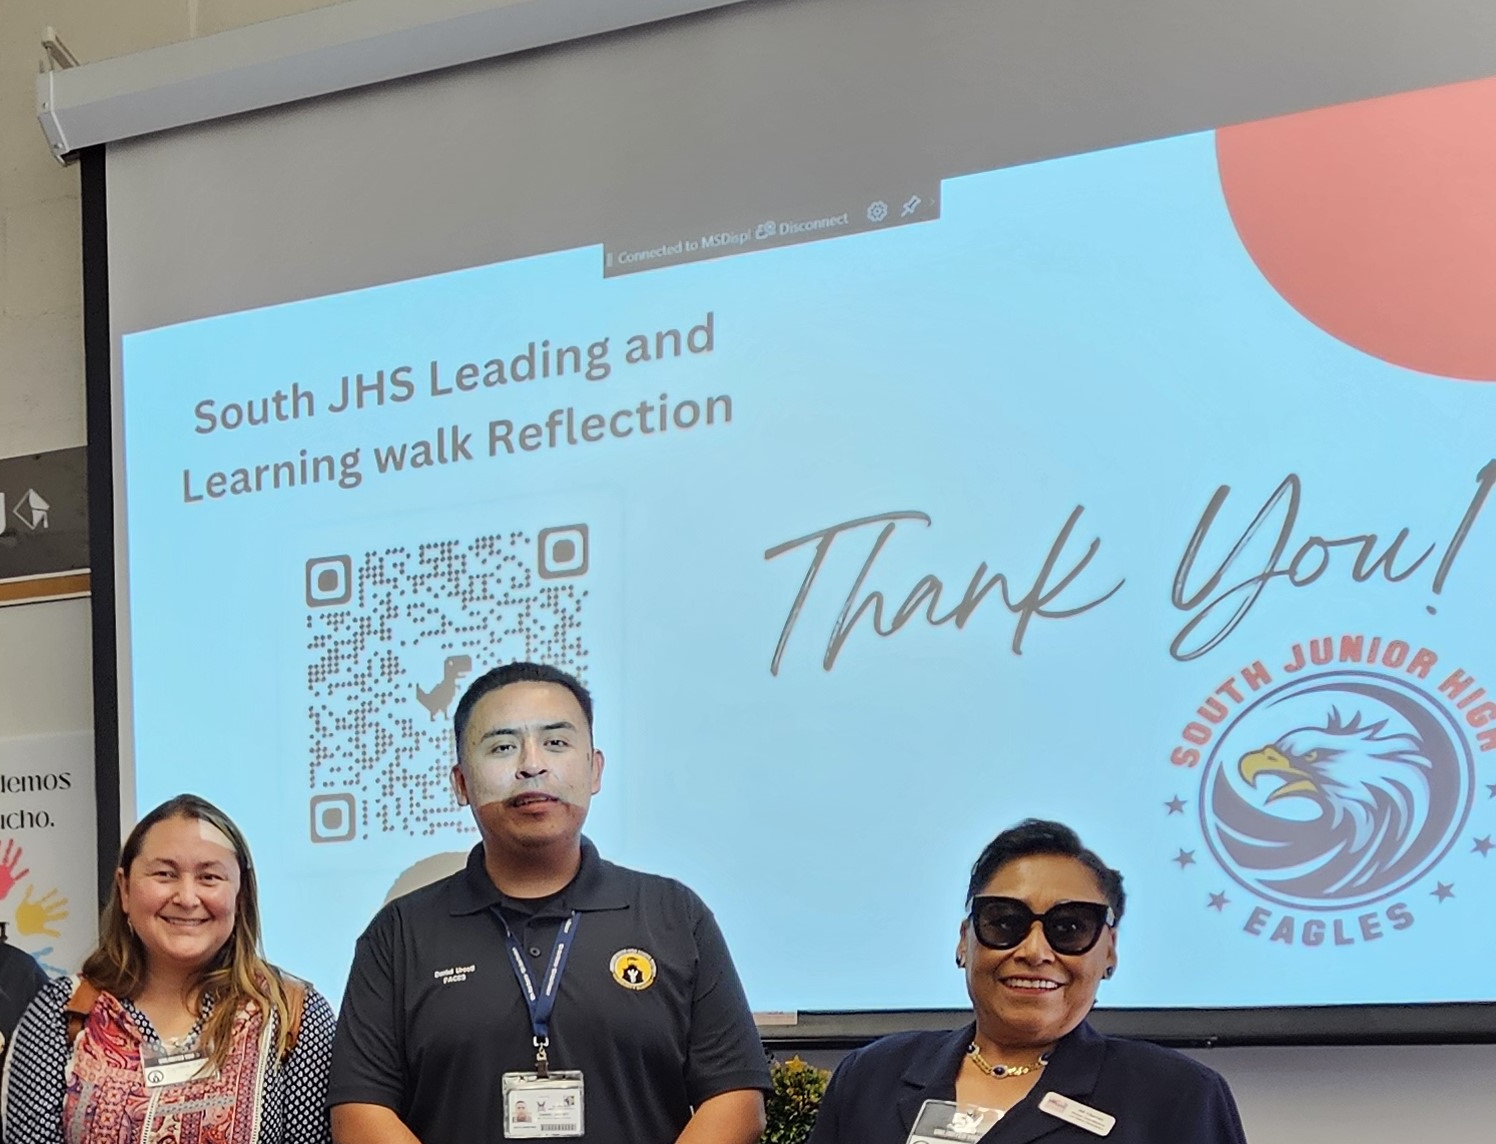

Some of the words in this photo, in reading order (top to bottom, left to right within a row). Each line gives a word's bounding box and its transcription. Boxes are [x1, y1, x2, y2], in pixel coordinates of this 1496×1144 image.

[617, 240, 683, 265] Connected
[686, 238, 699, 251] to
[779, 212, 849, 236] Disconnect
[194, 382, 314, 434] South
[327, 366, 415, 413] JHS
[431, 337, 611, 396] Leading
[625, 311, 714, 364] and
[183, 449, 363, 503] Learning
[373, 425, 473, 474] walk
[488, 393, 732, 456] Reflection
[764, 503, 1126, 677] Thank
[1170, 458, 1496, 662] You!
[1170, 660, 1273, 768] SOUTH
[1283, 634, 1438, 679] JUNIOR
[1243, 902, 1415, 946] EAGLES
